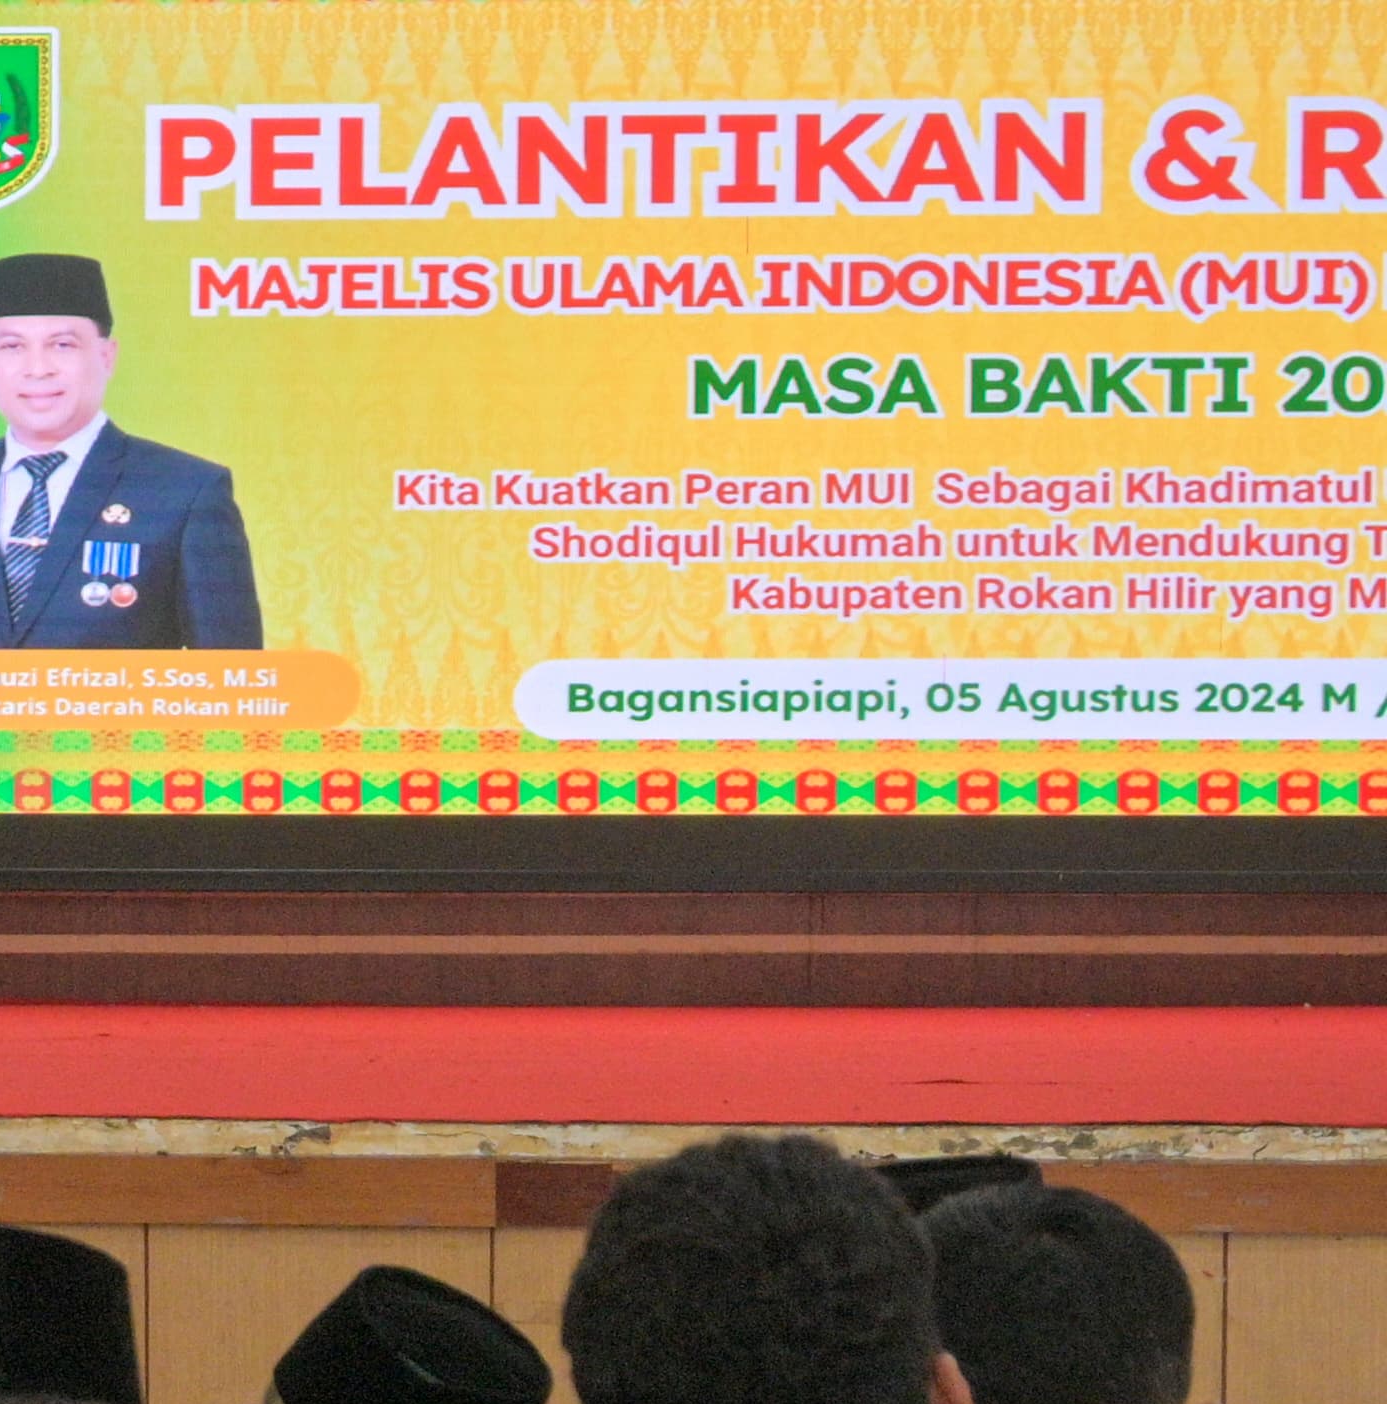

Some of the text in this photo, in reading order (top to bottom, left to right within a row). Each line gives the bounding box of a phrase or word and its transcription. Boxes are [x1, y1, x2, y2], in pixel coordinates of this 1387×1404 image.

[159, 111, 1087, 207] PELANTIKAN
[1144, 108, 1248, 202] &
[197, 258, 1369, 315] MAJELIS ULAMA INDONESIA (MUI)
[694, 355, 1385, 415] MASA BAKTI 20
[398, 471, 1372, 512] Kita Kuatkan Peran MUI Sebagai Khadimatul
[534, 526, 720, 566] Shodiqul
[736, 526, 941, 557] Hukumah
[957, 525, 1077, 557] untuk
[1094, 524, 1349, 565] Mendukung
[733, 578, 961, 617] Kabupaten
[978, 577, 1111, 609] Rokan
[1128, 577, 1216, 609] Hilir
[1229, 585, 1333, 618] yang
[46, 667, 135, 690] Efrizal,
[142, 668, 215, 690] S.Sos,
[223, 668, 279, 688] M.Si
[54, 698, 145, 717] Daerah
[152, 698, 231, 718] Rokan
[236, 698, 291, 718] Hilir
[568, 679, 911, 722] Bagansiapiapi,
[926, 682, 982, 713] 05
[999, 682, 1180, 721] Agustus
[1195, 682, 1304, 713] 2024
[1321, 682, 1357, 712] M
